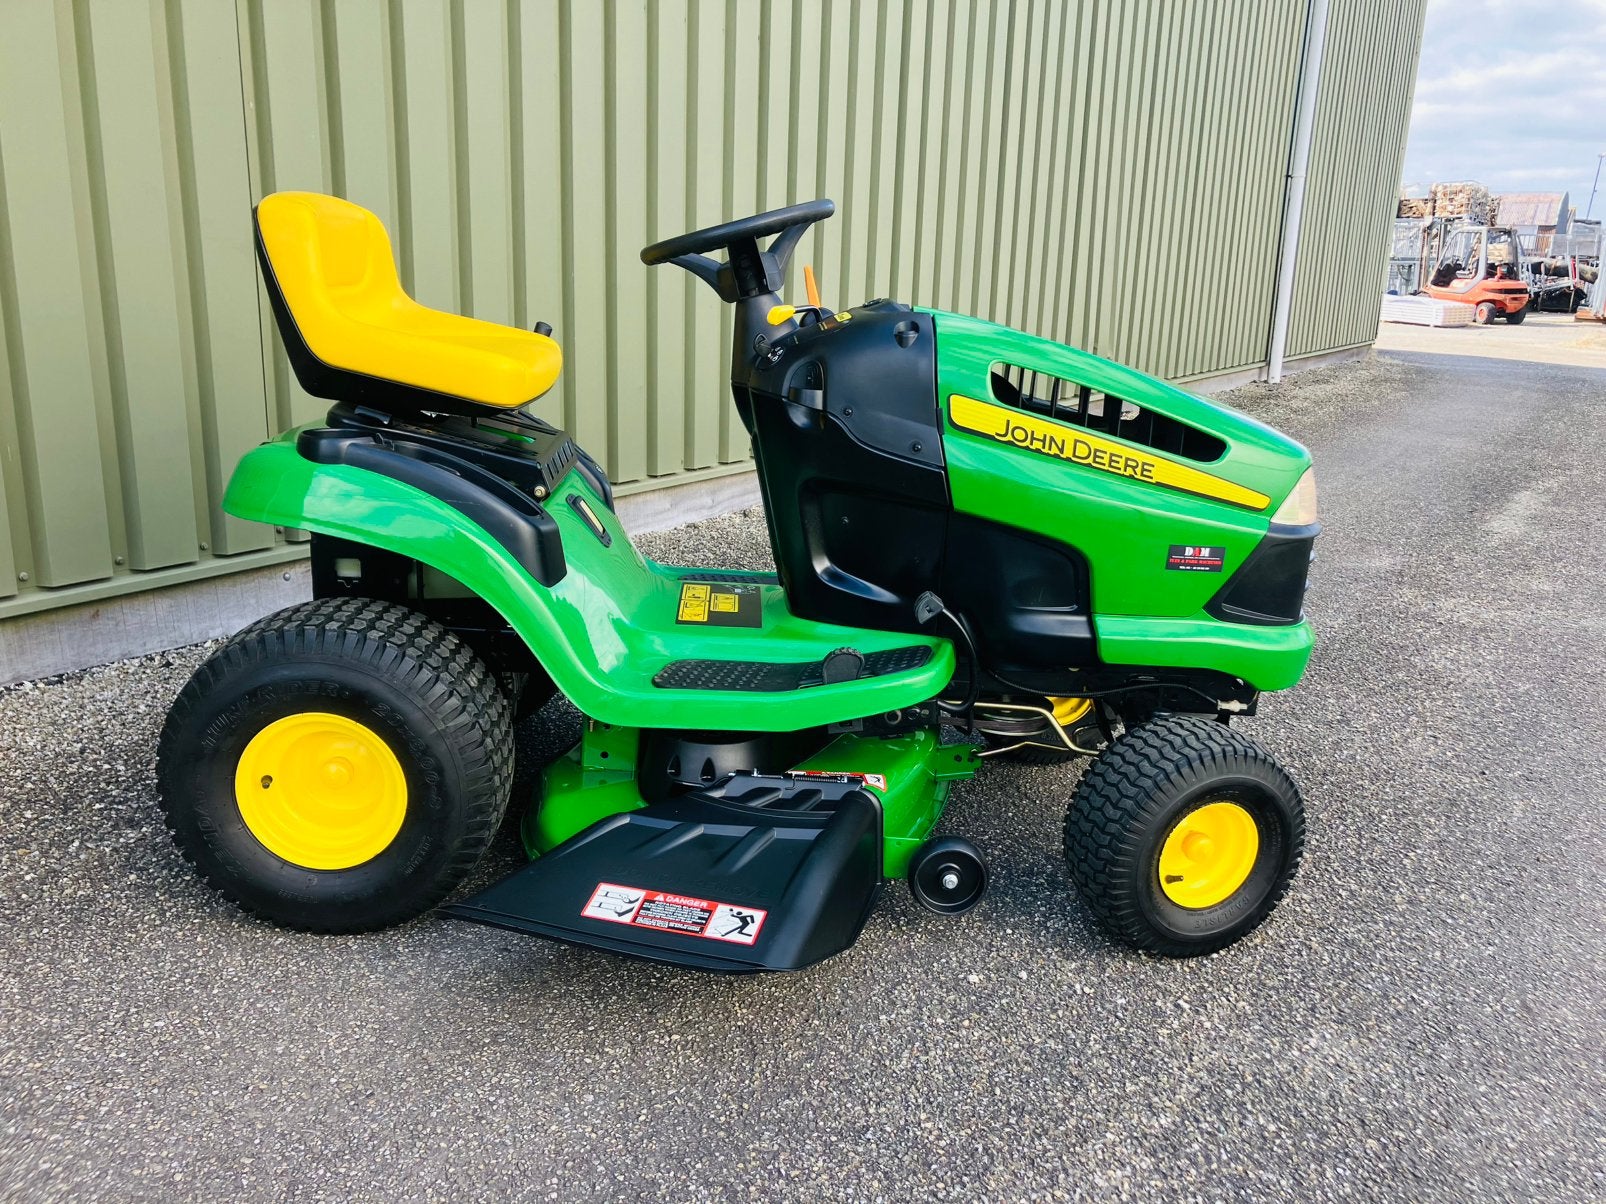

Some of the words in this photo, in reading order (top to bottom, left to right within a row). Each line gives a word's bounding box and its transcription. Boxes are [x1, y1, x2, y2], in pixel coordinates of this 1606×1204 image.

[995, 419, 1066, 455] JOHN
[1072, 438, 1155, 480] DEERE
[665, 895, 708, 909] DANGER
